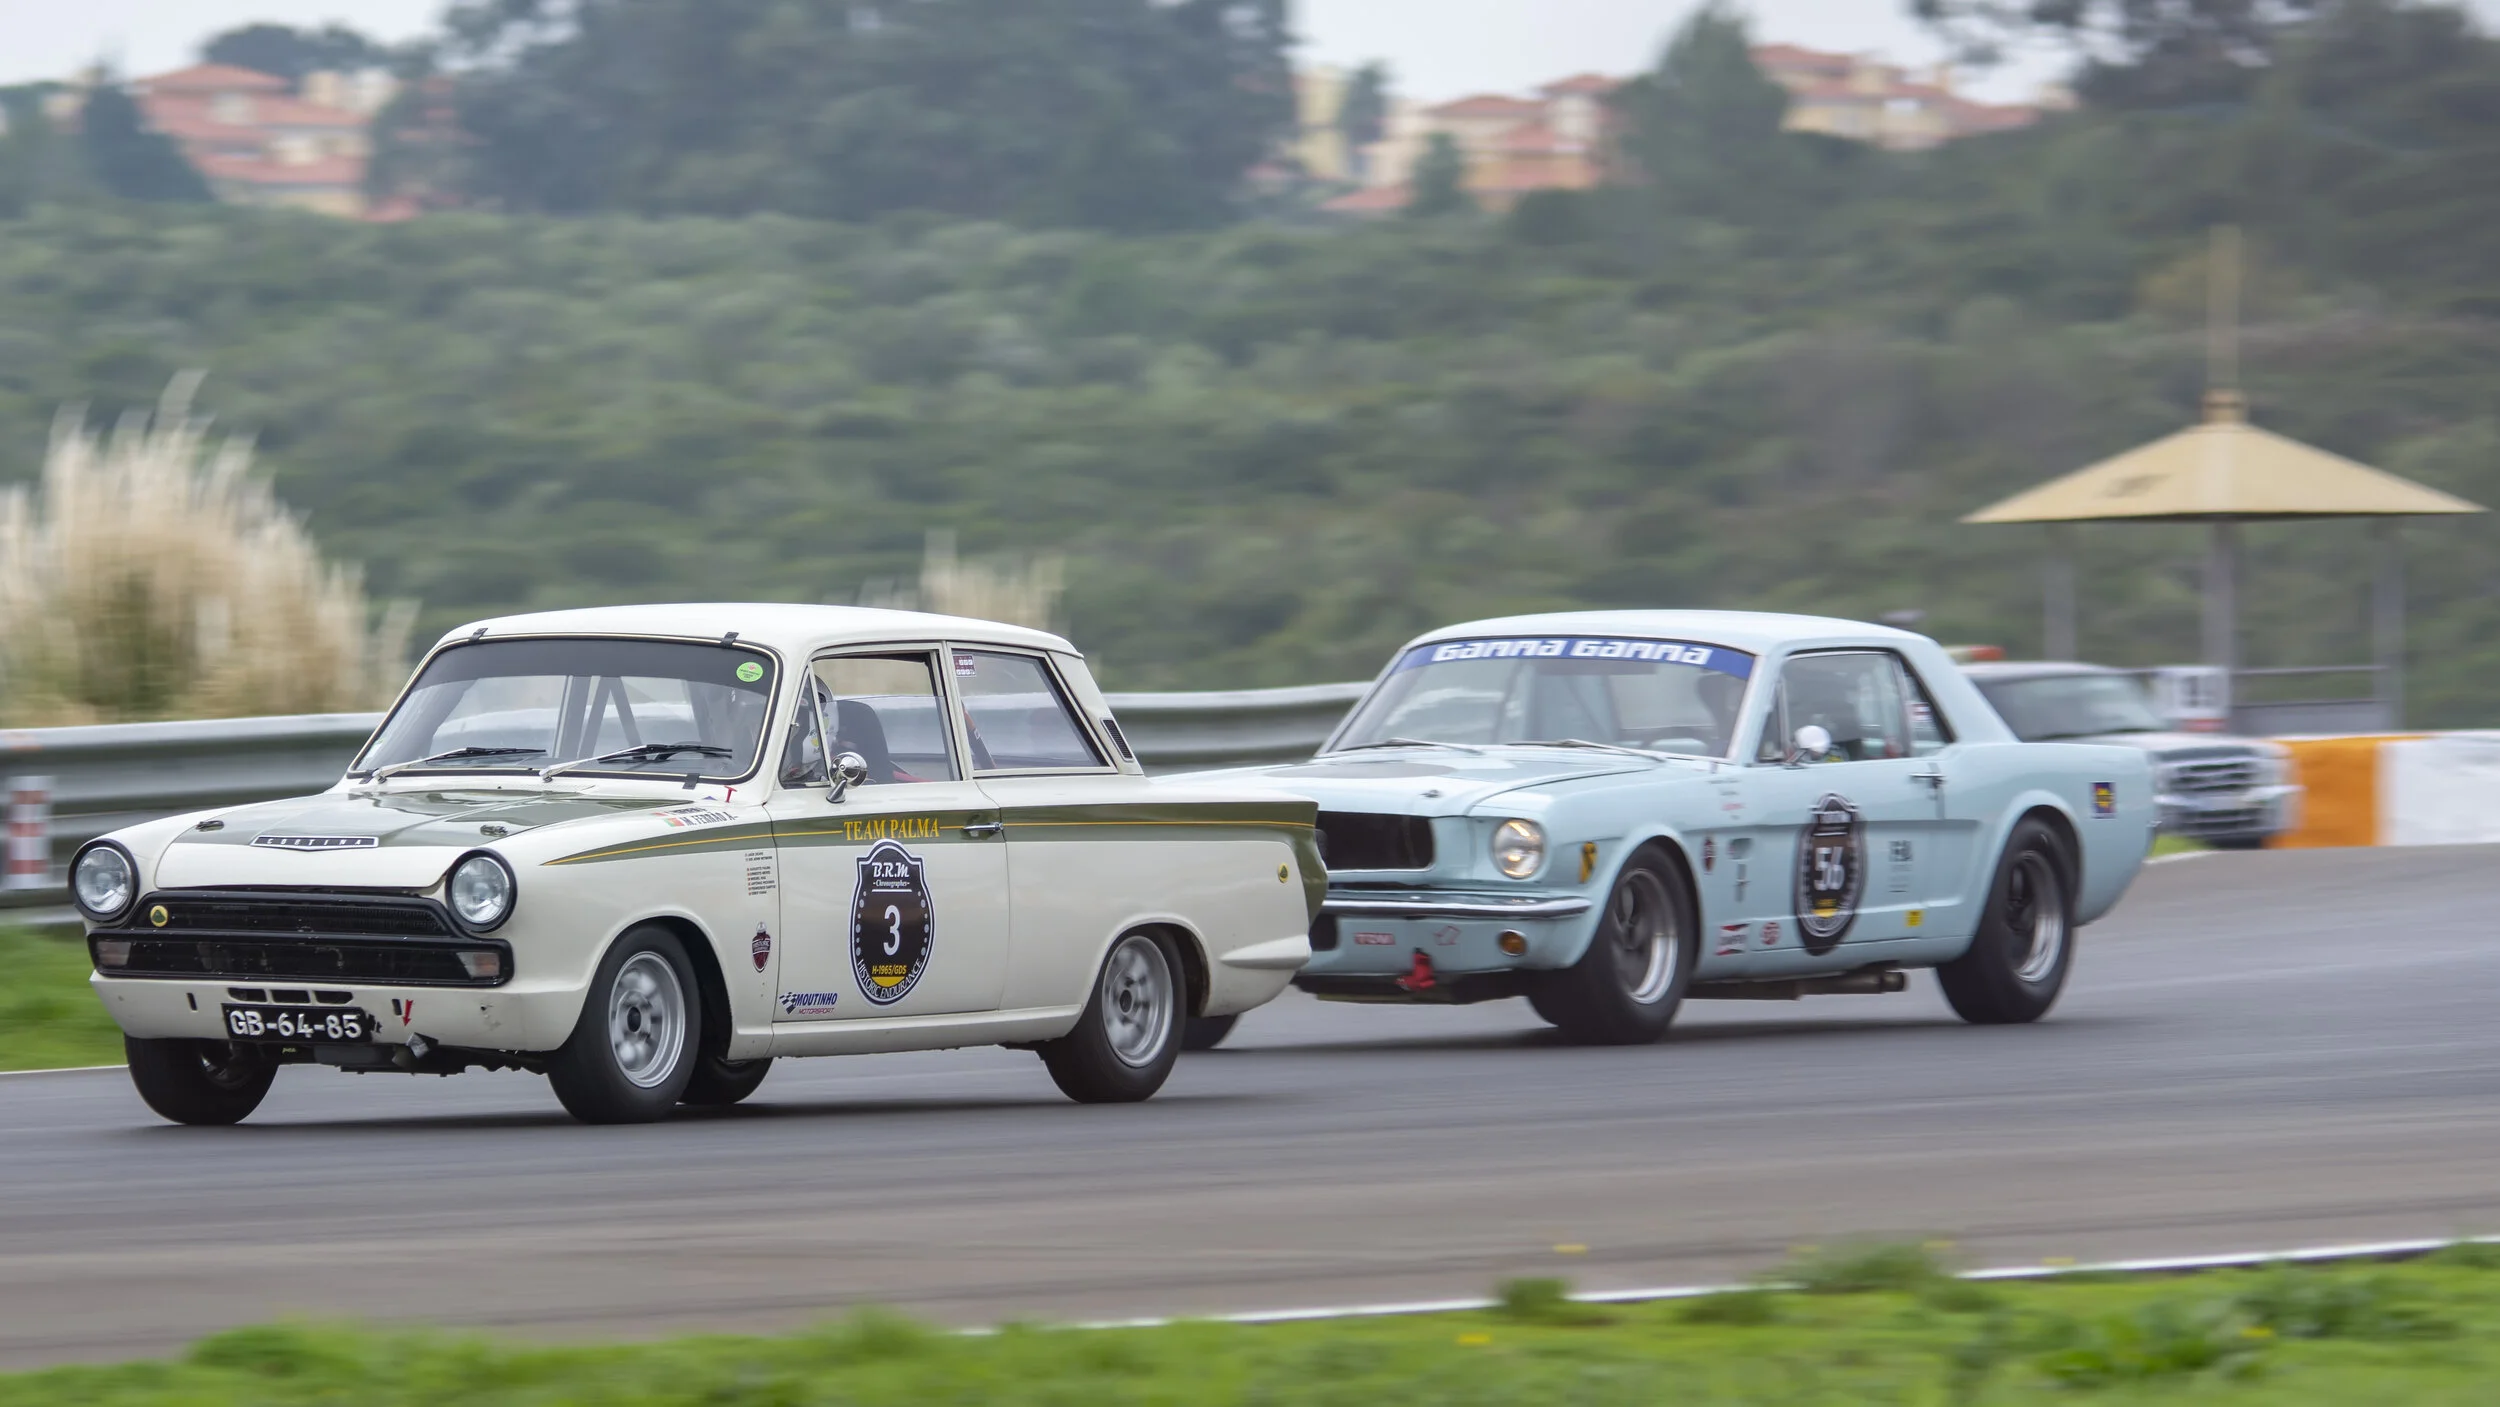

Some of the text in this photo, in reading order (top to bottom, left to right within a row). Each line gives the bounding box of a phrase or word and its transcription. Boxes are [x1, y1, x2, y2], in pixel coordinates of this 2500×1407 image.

[266, 838, 361, 846] CORTINA
[844, 817, 940, 841] TEAM PALMA
[1814, 846, 1846, 891] 56
[883, 904, 901, 956] 3
[857, 958, 924, 999] HISTORIC ENDURANCE
[871, 964, 908, 975] H-1965/GDS
[794, 992, 838, 1007] MOUTINHO
[229, 1010, 363, 1039] GB-64-85
